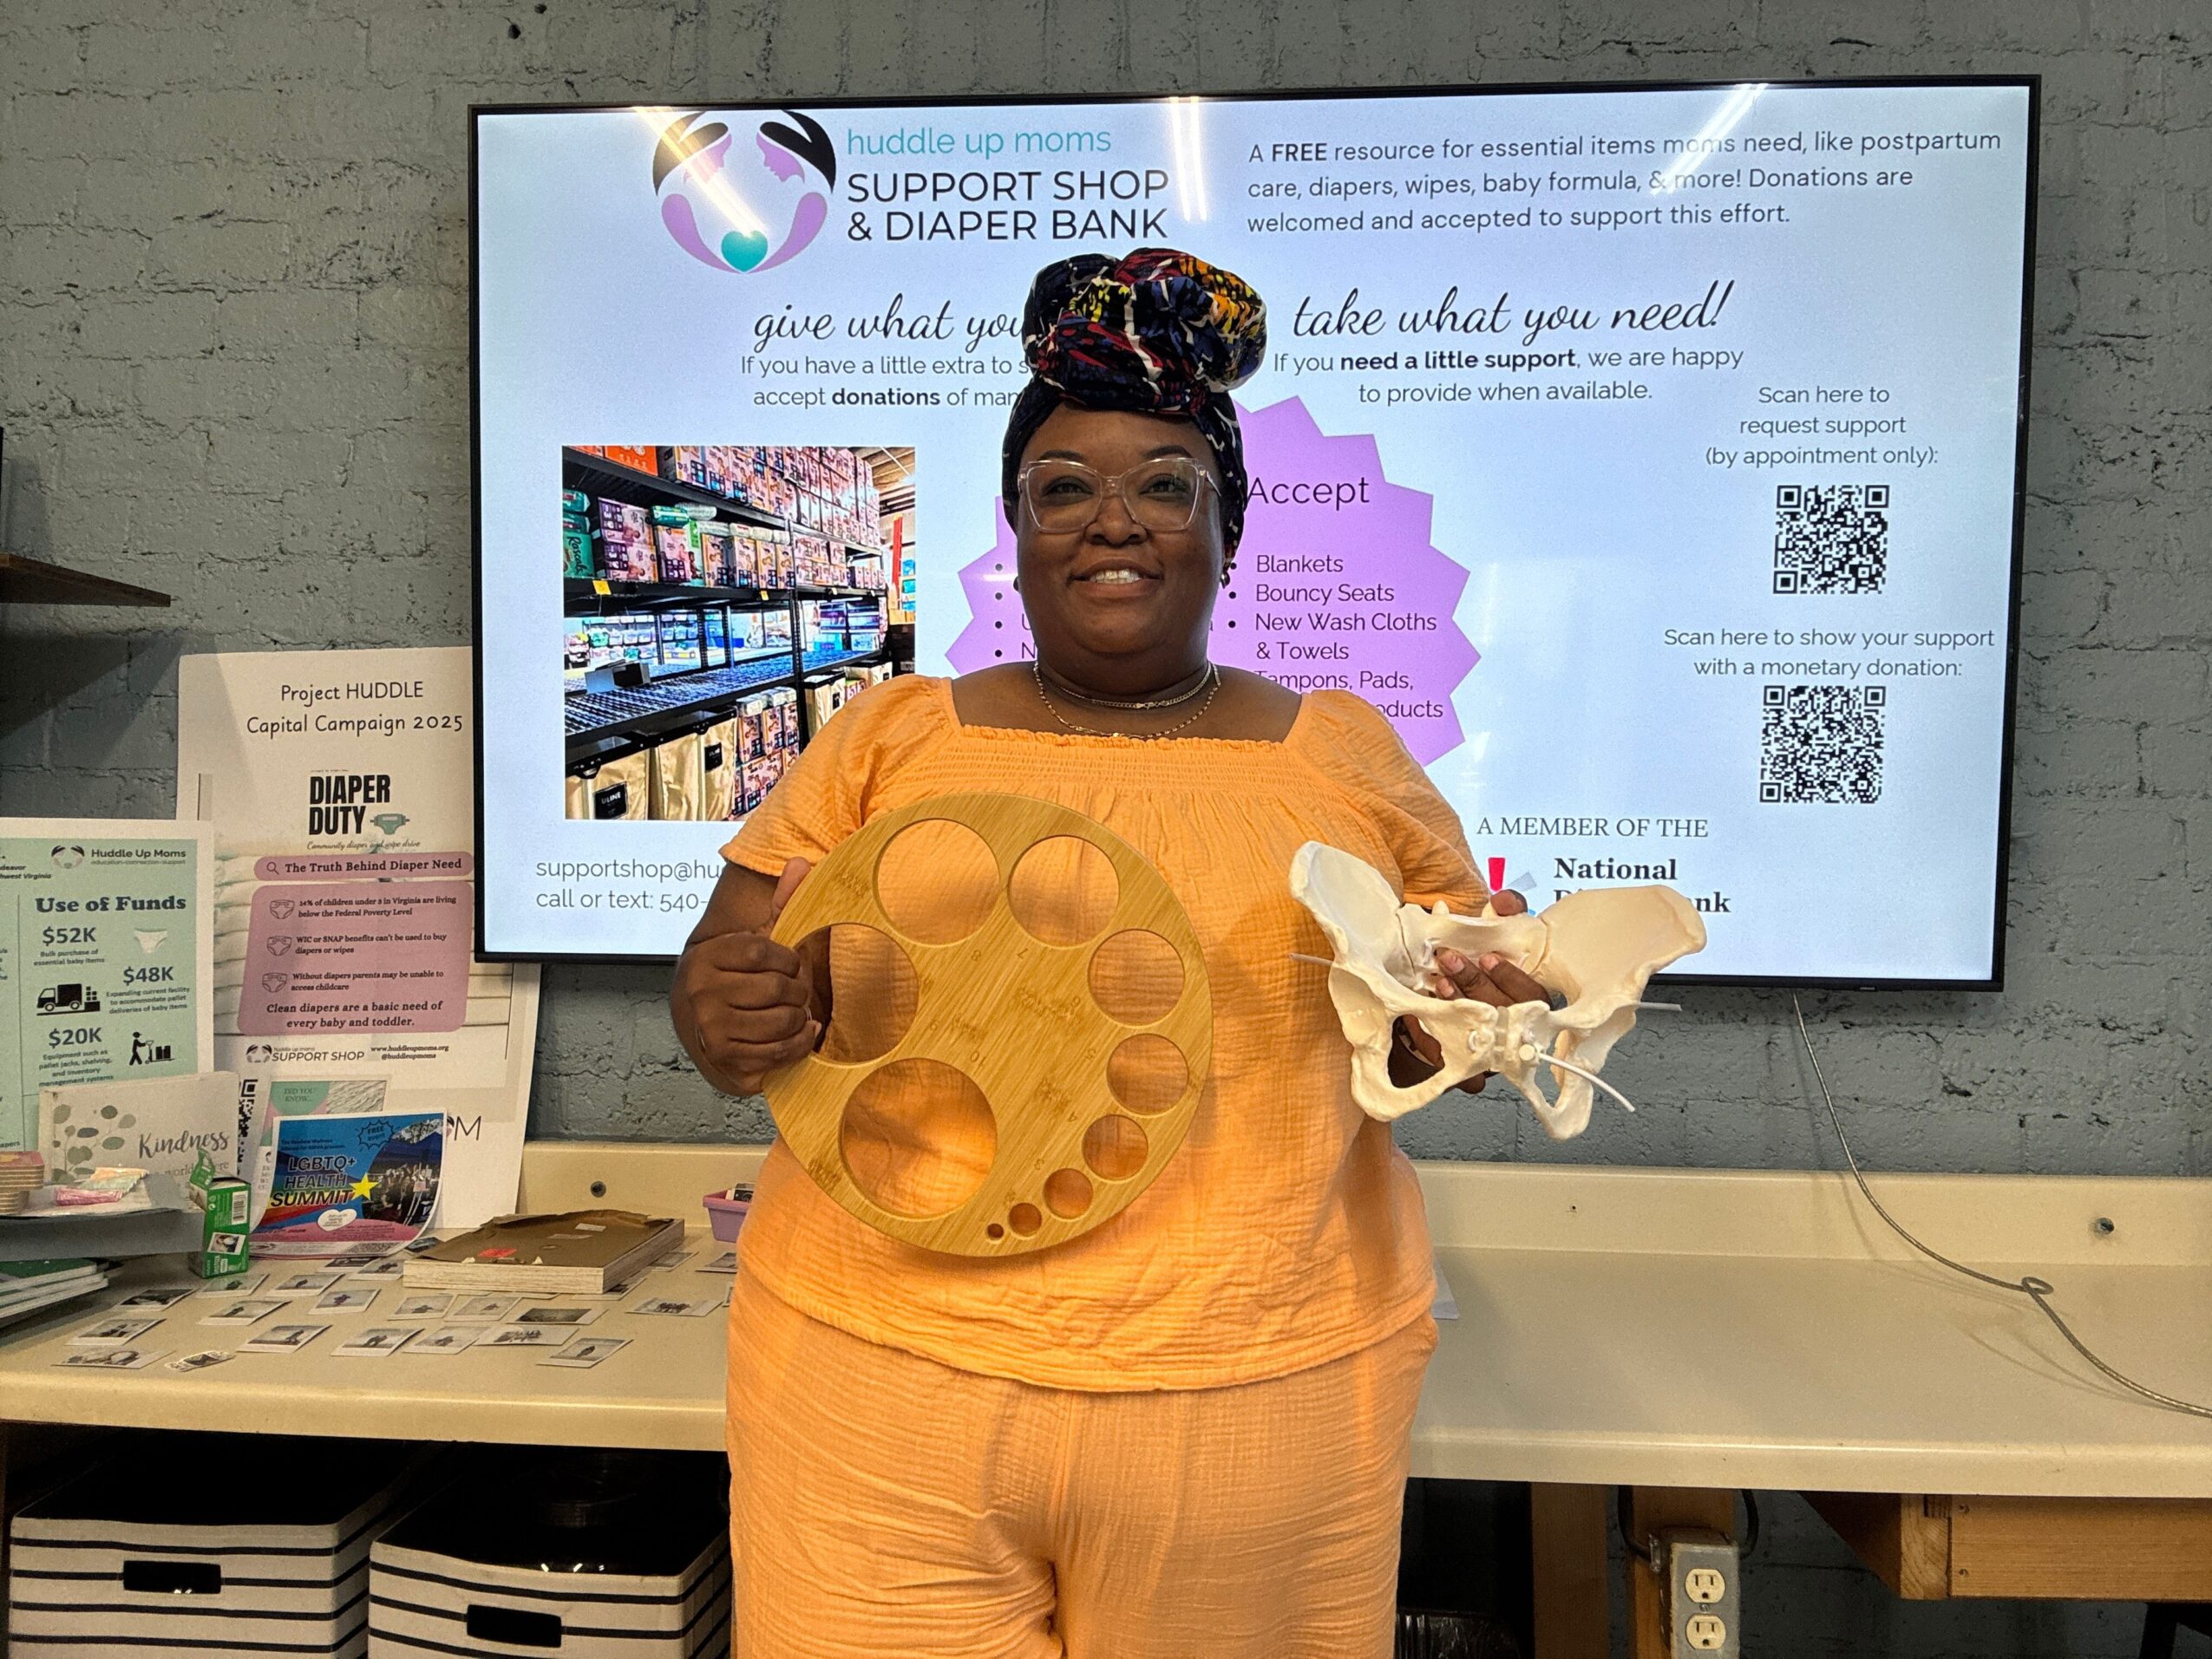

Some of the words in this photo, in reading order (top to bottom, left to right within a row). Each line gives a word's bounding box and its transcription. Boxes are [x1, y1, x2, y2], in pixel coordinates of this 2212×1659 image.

[847, 127, 956, 155] huddle
[965, 133, 1005, 158] up
[1015, 131, 1111, 153] moms
[1248, 144, 1264, 163] A
[1272, 143, 1328, 162] FREE
[1334, 142, 1435, 162] resource
[1441, 136, 1474, 159] for
[1481, 135, 1583, 157] essential
[1591, 134, 1655, 155] items
[1663, 138, 1736, 153] moms
[1744, 131, 1807, 154] need,
[1815, 130, 1853, 151] like
[1861, 132, 2000, 156] postpartum
[847, 171, 1042, 203] SUPPORT
[1053, 169, 1168, 201] SHOP
[1247, 182, 1302, 200] care,
[1309, 176, 1398, 202] diapers,
[1404, 173, 1476, 199] wipes,
[1483, 172, 1541, 198] baby
[1548, 169, 1641, 193] formula,
[1648, 170, 1664, 189] &
[1675, 168, 1741, 188] more!
[1749, 166, 1868, 187] Donations
[1876, 171, 1913, 186] are
[847, 211, 873, 241] &
[887, 210, 1037, 241] DIAPER
[1052, 208, 1168, 239] BANK
[1247, 210, 1364, 232] welcomed
[1371, 209, 1413, 230] and
[1421, 207, 1531, 234] accepted
[1539, 209, 1562, 226] to
[1570, 206, 1663, 232] support
[1670, 206, 1711, 224] this
[1720, 204, 1790, 223] effort.
[753, 304, 835, 353] give
[847, 292, 954, 339] what
[1293, 288, 1386, 336] take
[1398, 286, 1511, 335] what
[1522, 305, 1600, 346] you
[1610, 279, 1735, 331] need!
[742, 356, 756, 374] If
[759, 360, 799, 379] you
[805, 356, 856, 375] have
[861, 360, 874, 375] a
[880, 356, 926, 375] little
[932, 356, 985, 375] extra
[991, 356, 1012, 375] to
[1274, 353, 1289, 371] If
[1293, 357, 1333, 376] you
[1340, 351, 1398, 370] need
[1404, 356, 1418, 369] a
[1424, 350, 1479, 369] little
[1484, 349, 1580, 373] support,
[1587, 352, 1622, 367] we
[1628, 351, 1666, 366] are
[1672, 347, 1744, 369] happy
[753, 387, 827, 409] accept
[831, 387, 940, 406] donations
[946, 388, 969, 406] of
[1358, 384, 1381, 403] to
[1387, 382, 1472, 405] provide
[1477, 382, 1540, 402] when
[1546, 380, 1652, 401] available.
[1758, 387, 1810, 403] Scan
[1816, 385, 1863, 403] here
[1869, 386, 1890, 403] to
[1740, 416, 1820, 439] request
[1825, 416, 1907, 438] support
[1705, 447, 1738, 469] (by
[1743, 446, 1877, 469] appointment
[1882, 446, 1938, 468] only):
[1247, 477, 1370, 512] Accept
[1257, 554, 1344, 573] Blankets
[1256, 584, 1333, 606] Bouncy
[1338, 583, 1395, 602] Seats
[1255, 612, 1303, 631] New
[1307, 612, 1365, 631] Wash
[1371, 612, 1437, 630] Cloths
[1664, 629, 1715, 645] Scan
[1721, 628, 1769, 645] here
[1773, 629, 1795, 645] to
[1800, 628, 1856, 646] show
[1862, 632, 1909, 650] your
[1914, 630, 1995, 650] support
[1256, 641, 1271, 660] &
[1276, 641, 1350, 660] Towels
[1693, 657, 1737, 675] with
[1743, 662, 1755, 676] a
[1761, 659, 1862, 680] monetary
[1866, 658, 1962, 676] donation:
[1359, 670, 1414, 691] Pads,
[281, 684, 341, 708] Project
[346, 681, 423, 700] HUDDLE
[246, 714, 308, 738] Capital
[315, 713, 405, 736] Campaign
[413, 715, 462, 732] 2025
[310, 774, 391, 805] DIAPER
[600, 790, 623, 805] ULINE
[308, 805, 367, 836] DUTY
[1476, 817, 1494, 835] A
[1500, 817, 1610, 836] MEMBER
[1616, 818, 1650, 837] OF
[1656, 819, 1709, 838] THE
[91, 849, 134, 858] Huddle
[135, 849, 152, 859] Up
[154, 849, 187, 858] Moms
[306, 841, 345, 851] Community
[347, 840, 368, 851] diaper
[402, 839, 421, 848] drive
[285, 862, 306, 873] The
[309, 861, 343, 872] Truth
[345, 859, 387, 872] Behind
[389, 859, 429, 872] Diaper
[432, 858, 462, 869] Need
[1554, 857, 1677, 880] National
[35, 898, 80, 913] Use
[85, 896, 110, 912] of
[115, 895, 187, 911] Funds
[536, 888, 575, 908] call
[579, 893, 603, 908] or
[607, 890, 653, 909] text:
[42, 925, 96, 947] $52K
[123, 966, 174, 986] $48K
[266, 1003, 297, 1013] Clean
[299, 1003, 340, 1015] diapers
[371, 1002, 400, 1011] basic
[402, 1000, 429, 1011] need
[430, 1000, 444, 1010] of
[286, 1020, 317, 1029] every
[319, 1017, 347, 1029] baby
[349, 1016, 370, 1027] and
[372, 1016, 415, 1027] toddler.
[49, 1027, 102, 1049] $20K
[272, 1051, 329, 1062] SUPPORT
[330, 1050, 365, 1061] SHOP
[139, 1131, 229, 1159] Kindness
[287, 1155, 357, 1174] LGBTQ+
[285, 1173, 347, 1190] HEALTH
[270, 1190, 355, 1207] SUMMIT
